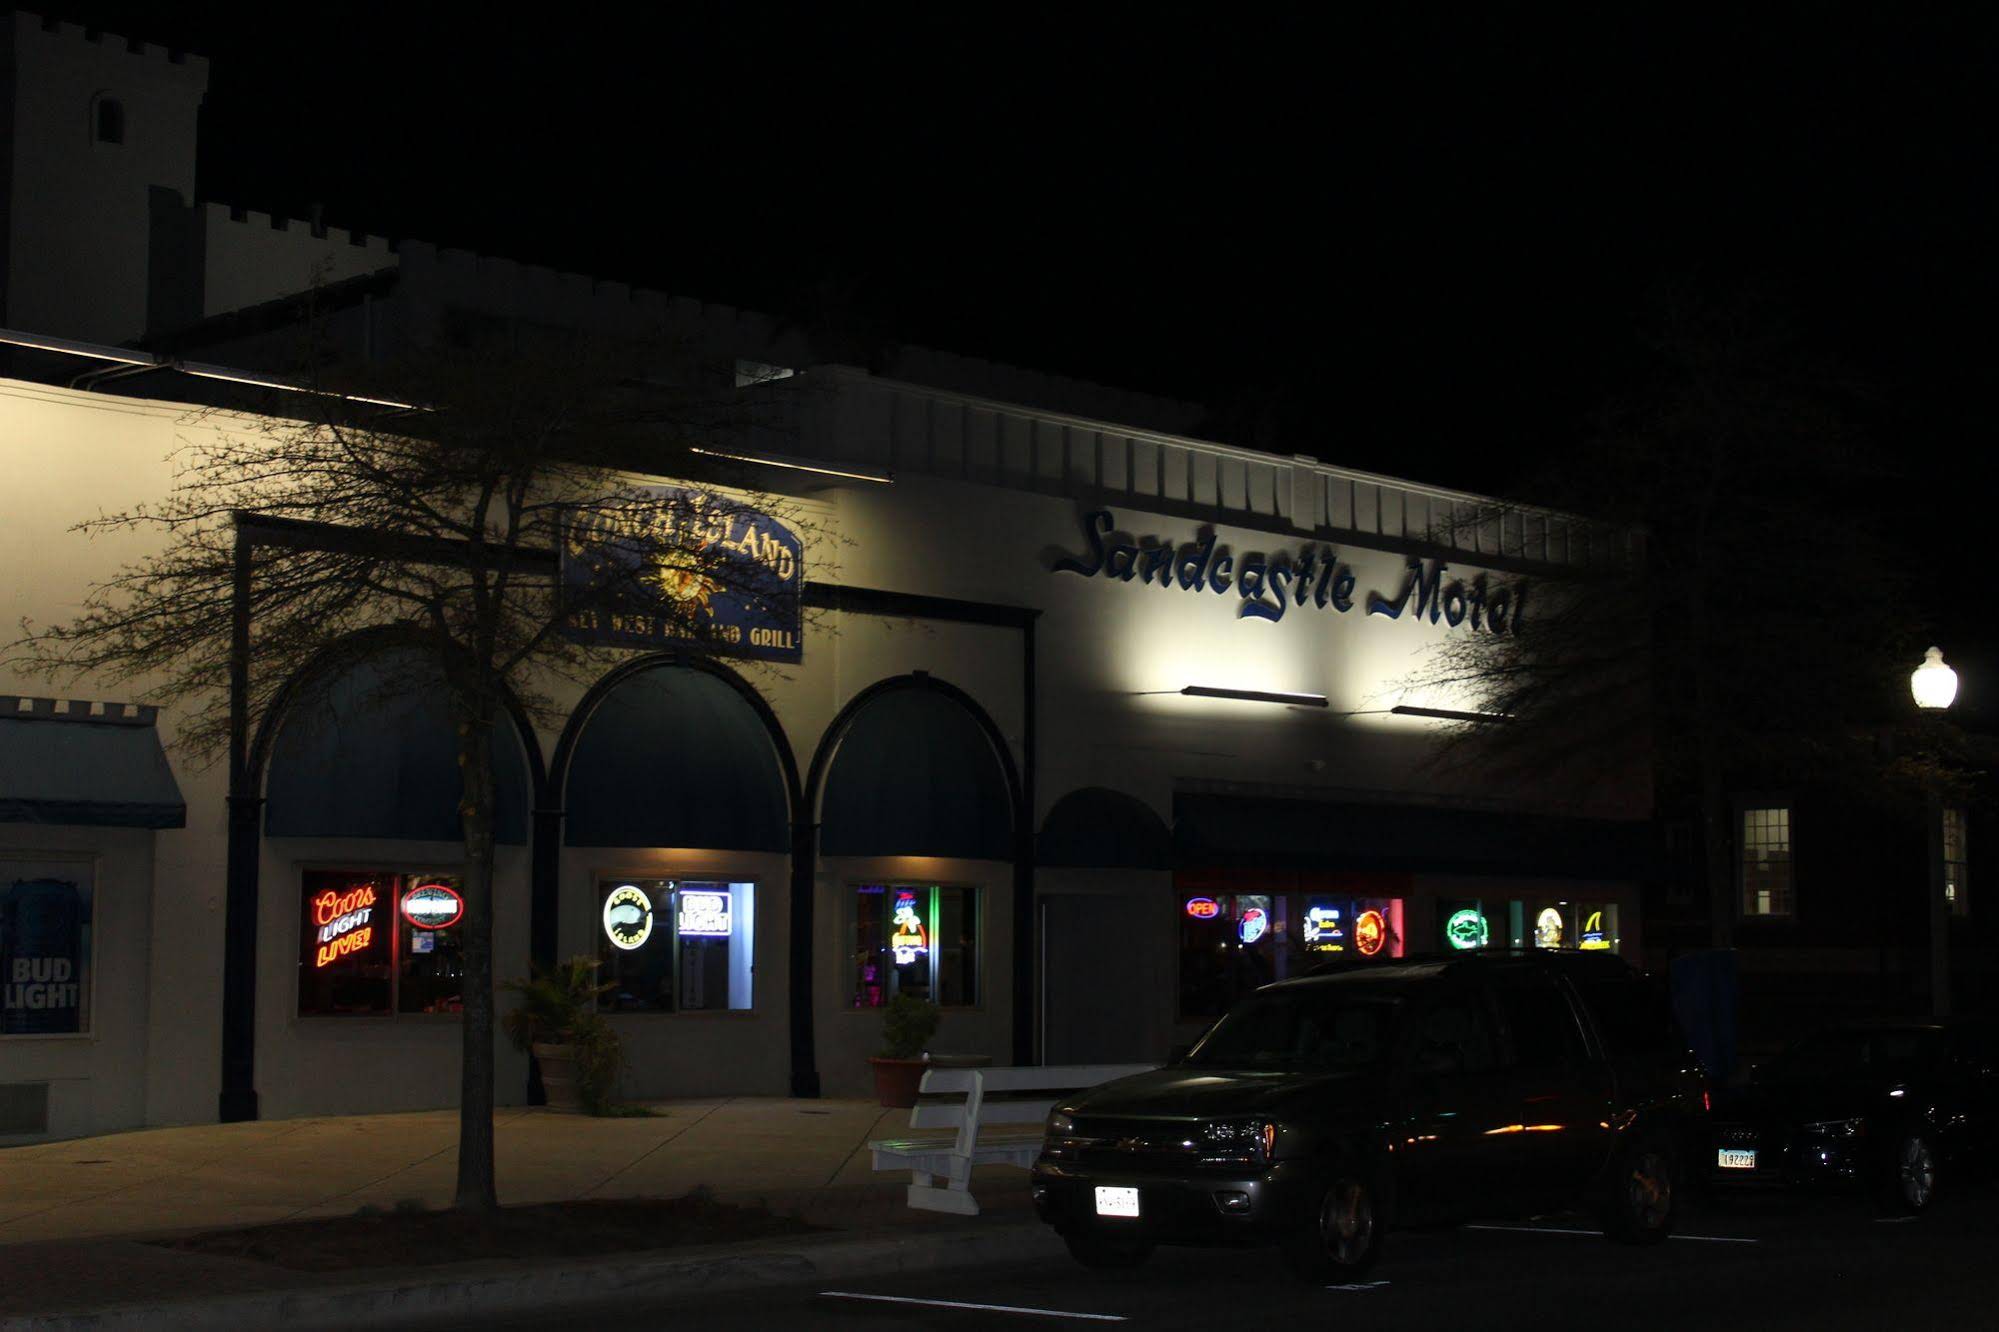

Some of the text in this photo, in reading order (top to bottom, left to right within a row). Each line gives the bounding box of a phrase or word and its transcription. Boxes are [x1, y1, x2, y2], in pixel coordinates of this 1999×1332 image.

[689, 494, 795, 581] ISLAND
[1052, 510, 1525, 635] Sandcastle Motel
[749, 627, 796, 650] GRILL
[316, 885, 376, 925] Coors
[1188, 902, 1218, 915] OPEN
[319, 907, 373, 943] LIGHT
[316, 926, 372, 968] LIVE!
[12, 957, 72, 983] BUD
[5, 983, 79, 1009] LIGHT
